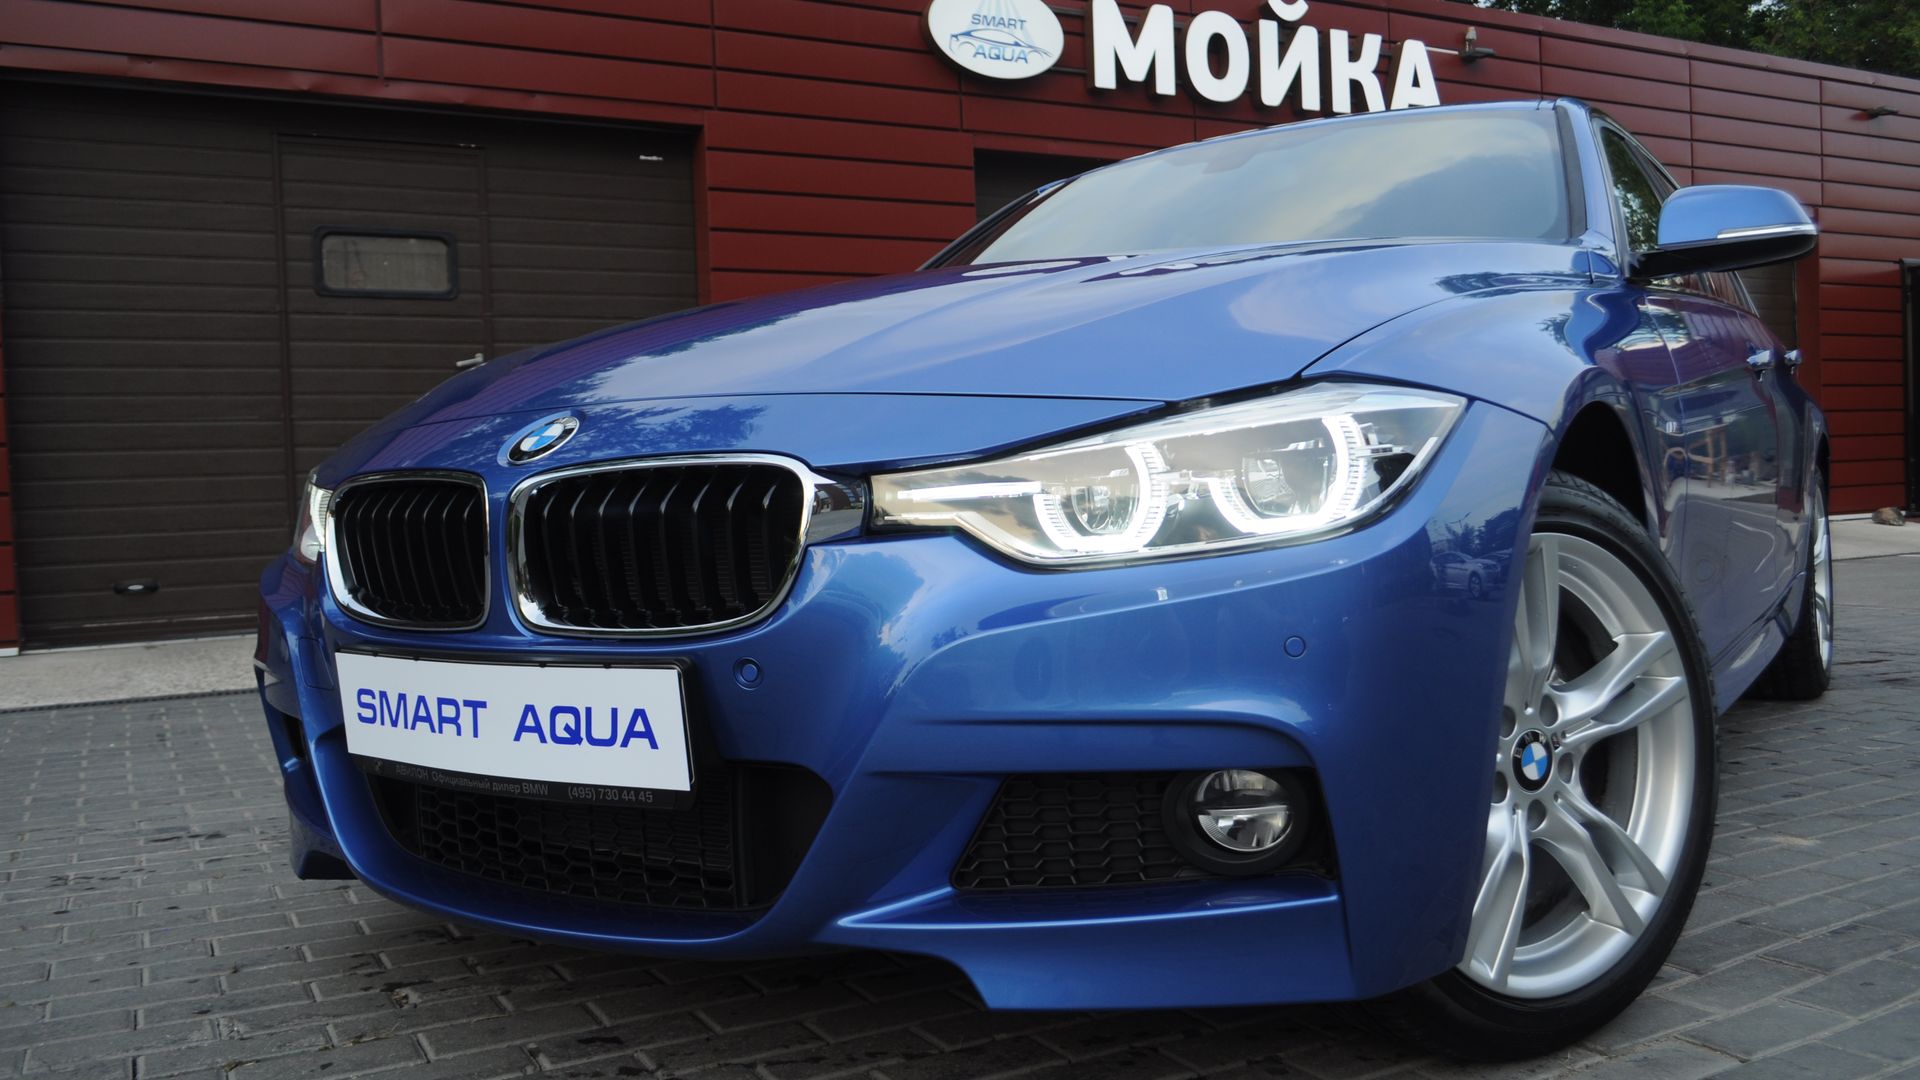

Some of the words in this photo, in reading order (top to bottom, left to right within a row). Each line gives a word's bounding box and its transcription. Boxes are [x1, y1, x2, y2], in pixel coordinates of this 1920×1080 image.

[971, 13, 1027, 31] SMART
[973, 44, 1029, 64] AQUA
[1091, 0, 1441, 114] МОЙКА
[356, 687, 488, 738] SMART
[513, 703, 660, 750] AQUA
[492, 782, 521, 794] дилер
[521, 782, 549, 797] BMW
[567, 785, 597, 801] (495)
[597, 788, 619, 801] 730
[620, 789, 637, 802] 44
[638, 791, 654, 803] 45
